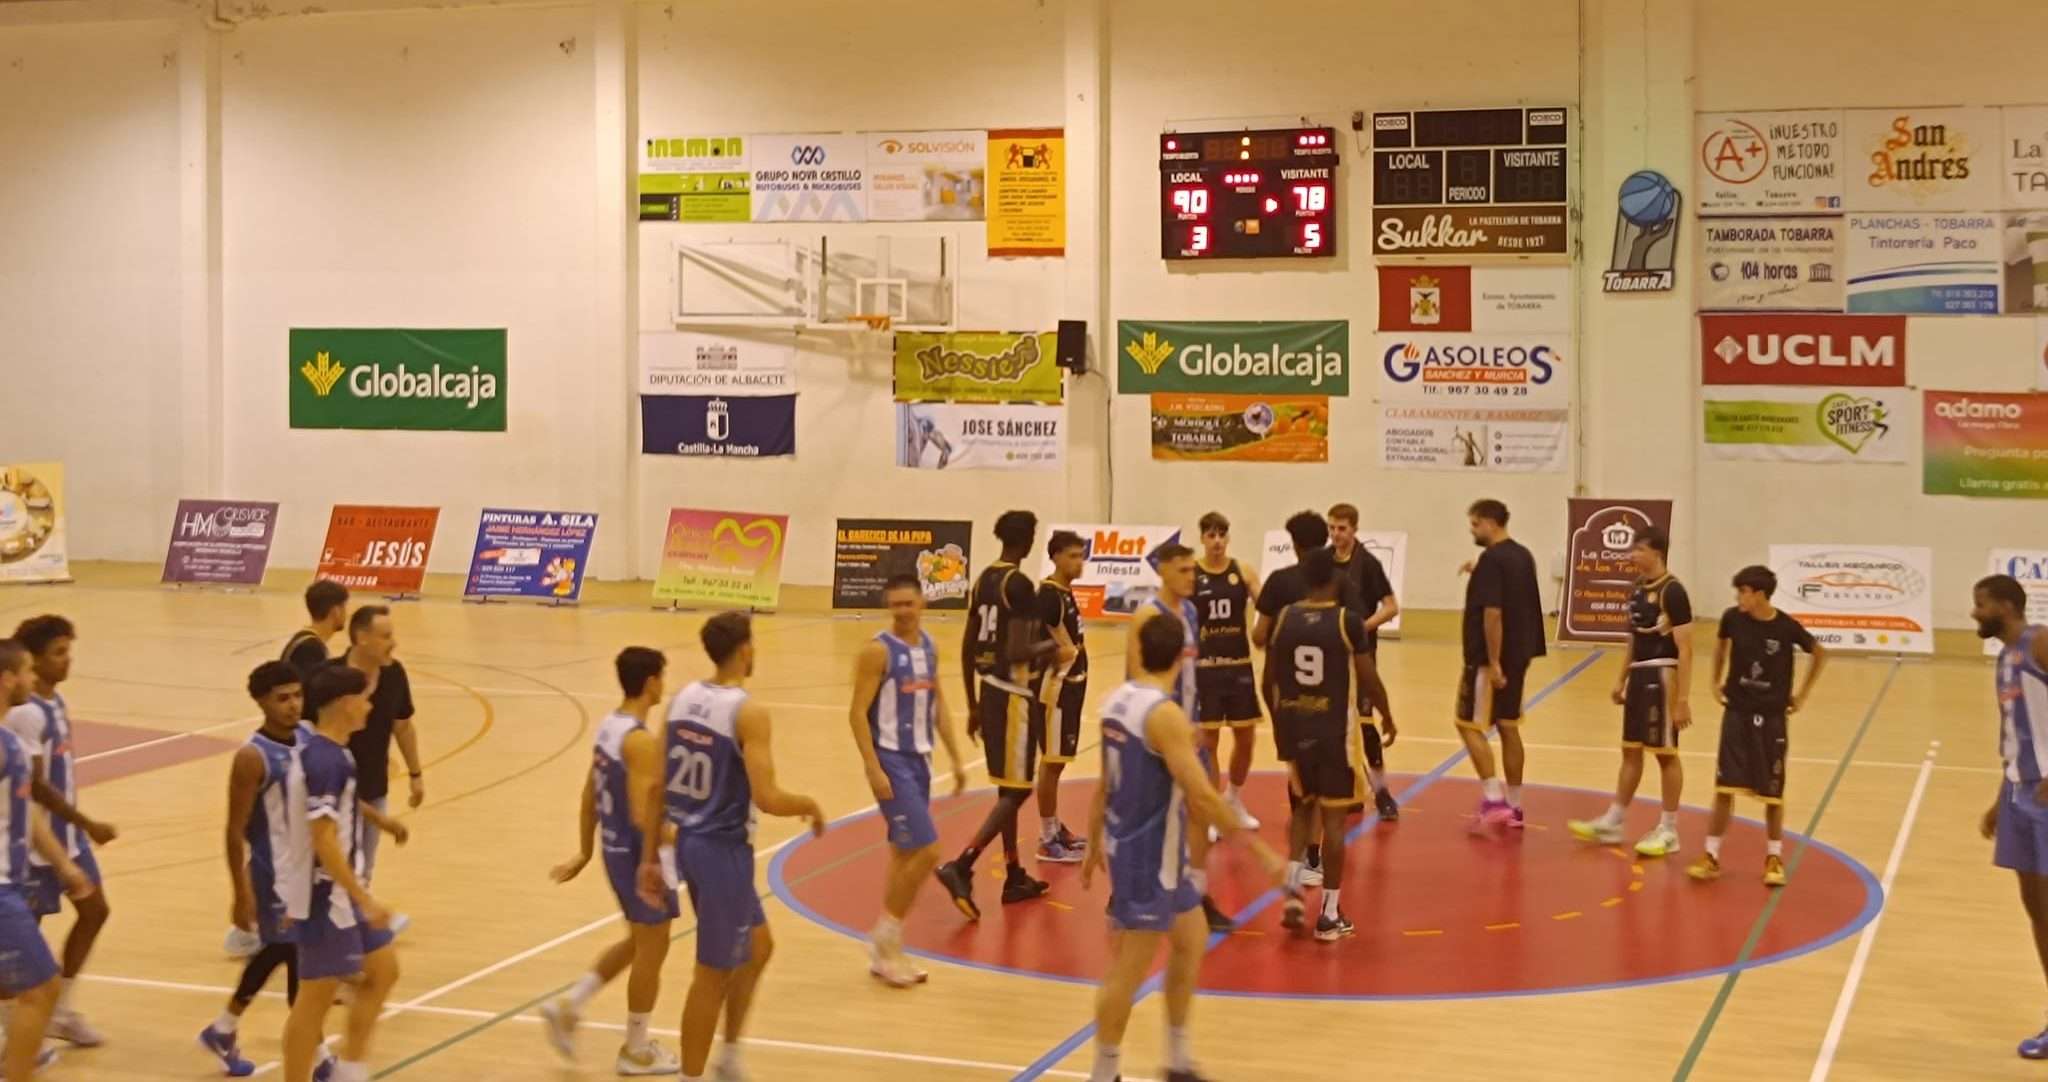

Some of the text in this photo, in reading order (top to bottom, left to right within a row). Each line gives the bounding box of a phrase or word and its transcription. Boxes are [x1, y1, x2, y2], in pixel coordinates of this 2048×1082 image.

[1886, 116, 1945, 151] San
[2013, 139, 2042, 159] La
[1389, 154, 1429, 169] LOCAL
[1503, 152, 1559, 167] VISITANTE
[1868, 148, 1969, 187] Andrés
[755, 169, 862, 181] GRUPO NOVA CASTILLO
[1171, 173, 1203, 183] LOCAL
[1281, 169, 1329, 179] VISITANTE
[1772, 163, 1835, 180] FUNCIONA!
[1174, 189, 1207, 213] 90
[1293, 186, 1325, 210] 78
[1448, 187, 1486, 200] PERIODO
[1378, 215, 1488, 250] Sukkar
[1850, 219, 1920, 230] PLANCHAS
[1934, 217, 1993, 229] TOBARRA
[1192, 226, 1207, 250] 3
[1304, 223, 1320, 247] 5
[1706, 228, 1834, 241] TAMBORADA TOBARRA
[1943, 236, 1976, 249] Paco
[1741, 261, 1798, 280] 104 horas
[1747, 333, 1895, 366] UCLM
[1179, 343, 1342, 386] Globalcaja
[349, 363, 497, 409] Globalcaja
[715, 374, 727, 384] DE
[732, 374, 785, 385] ALBACETE
[1448, 386, 1469, 395] 967
[1475, 386, 1489, 395] 30
[1493, 386, 1508, 395] 49
[1827, 404, 1870, 426] SPORT
[962, 419, 993, 435] JOSE
[726, 443, 759, 455] Mancha
[482, 513, 594, 527] PINTURAS A. SILA
[1093, 530, 1147, 555] Mat
[361, 537, 426, 568] JESÚS
[1096, 564, 1141, 576] Iniesta
[1208, 599, 1231, 620] 10
[1294, 645, 1324, 686] 9
[666, 745, 713, 800] 20
